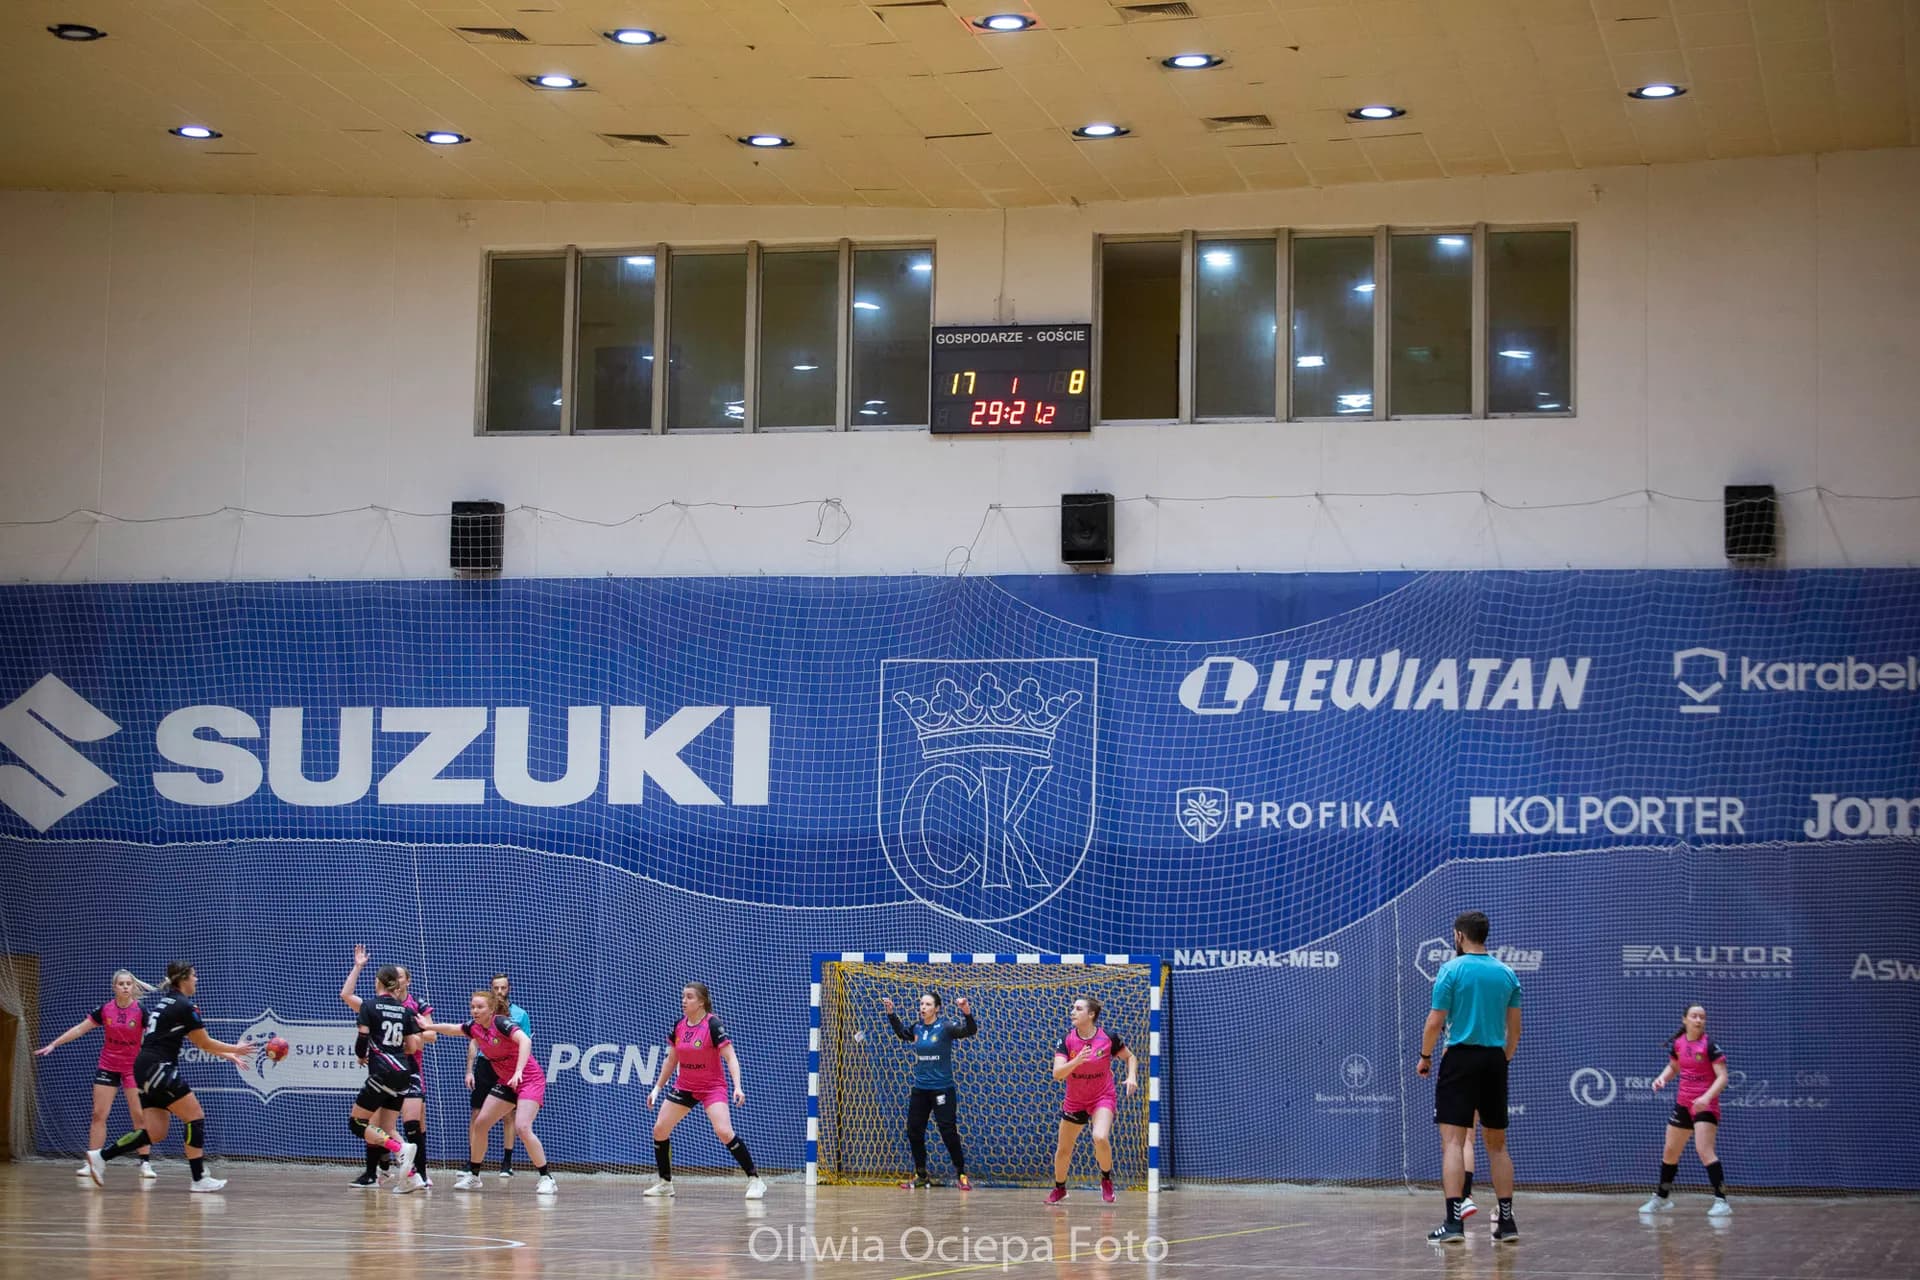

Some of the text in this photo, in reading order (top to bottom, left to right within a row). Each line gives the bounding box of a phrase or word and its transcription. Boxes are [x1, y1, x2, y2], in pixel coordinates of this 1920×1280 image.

[936, 332, 1023, 344] GOSPODARZE
[1037, 328, 1085, 342] GOŚCIE
[952, 371, 976, 395] 17
[1068, 369, 1085, 394] 8
[1263, 648, 1591, 712] LEWIATAN
[1741, 656, 1920, 691] karabel
[153, 705, 771, 807] SUZUKI
[900, 763, 1053, 888] CK
[1235, 801, 1399, 829] PROFIKA
[1498, 795, 1745, 835] KOLPORTER
[1803, 793, 1920, 839] Jom
[1648, 945, 1792, 963] ALUTOR
[382, 1020, 404, 1047] 26
[296, 1044, 356, 1056] SUPERL
[546, 1043, 672, 1085] PGN
[313, 1061, 356, 1069] KOBIE
